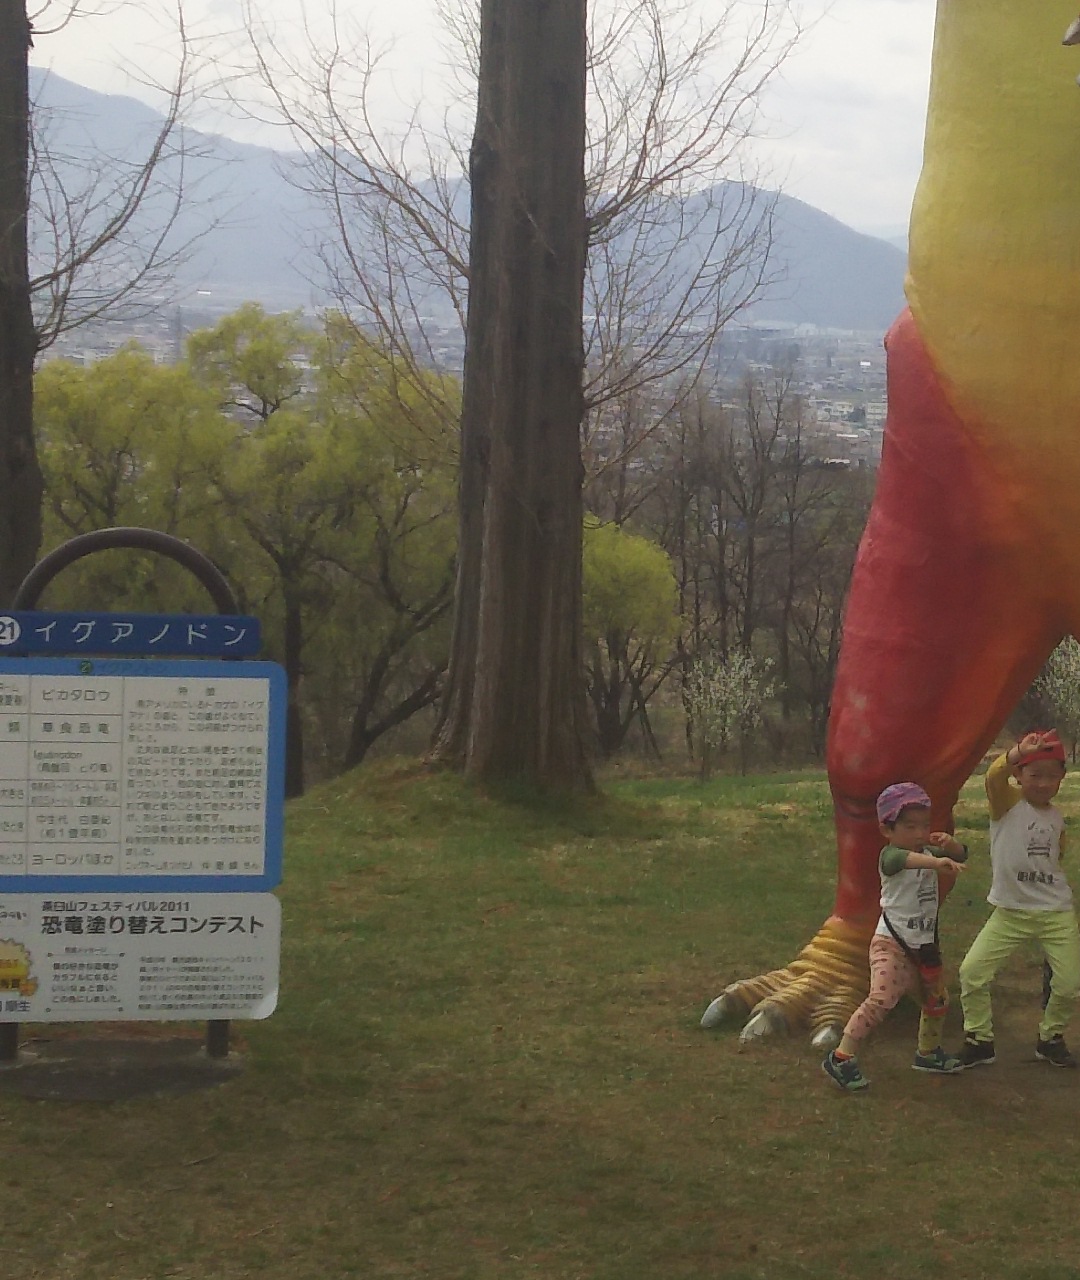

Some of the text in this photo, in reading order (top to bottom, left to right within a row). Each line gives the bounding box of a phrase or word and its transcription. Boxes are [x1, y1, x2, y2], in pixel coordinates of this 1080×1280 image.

[35, 620, 247, 646] イグアノドン
[41, 915, 265, 935] 恐竜塗り替えコンテスト
